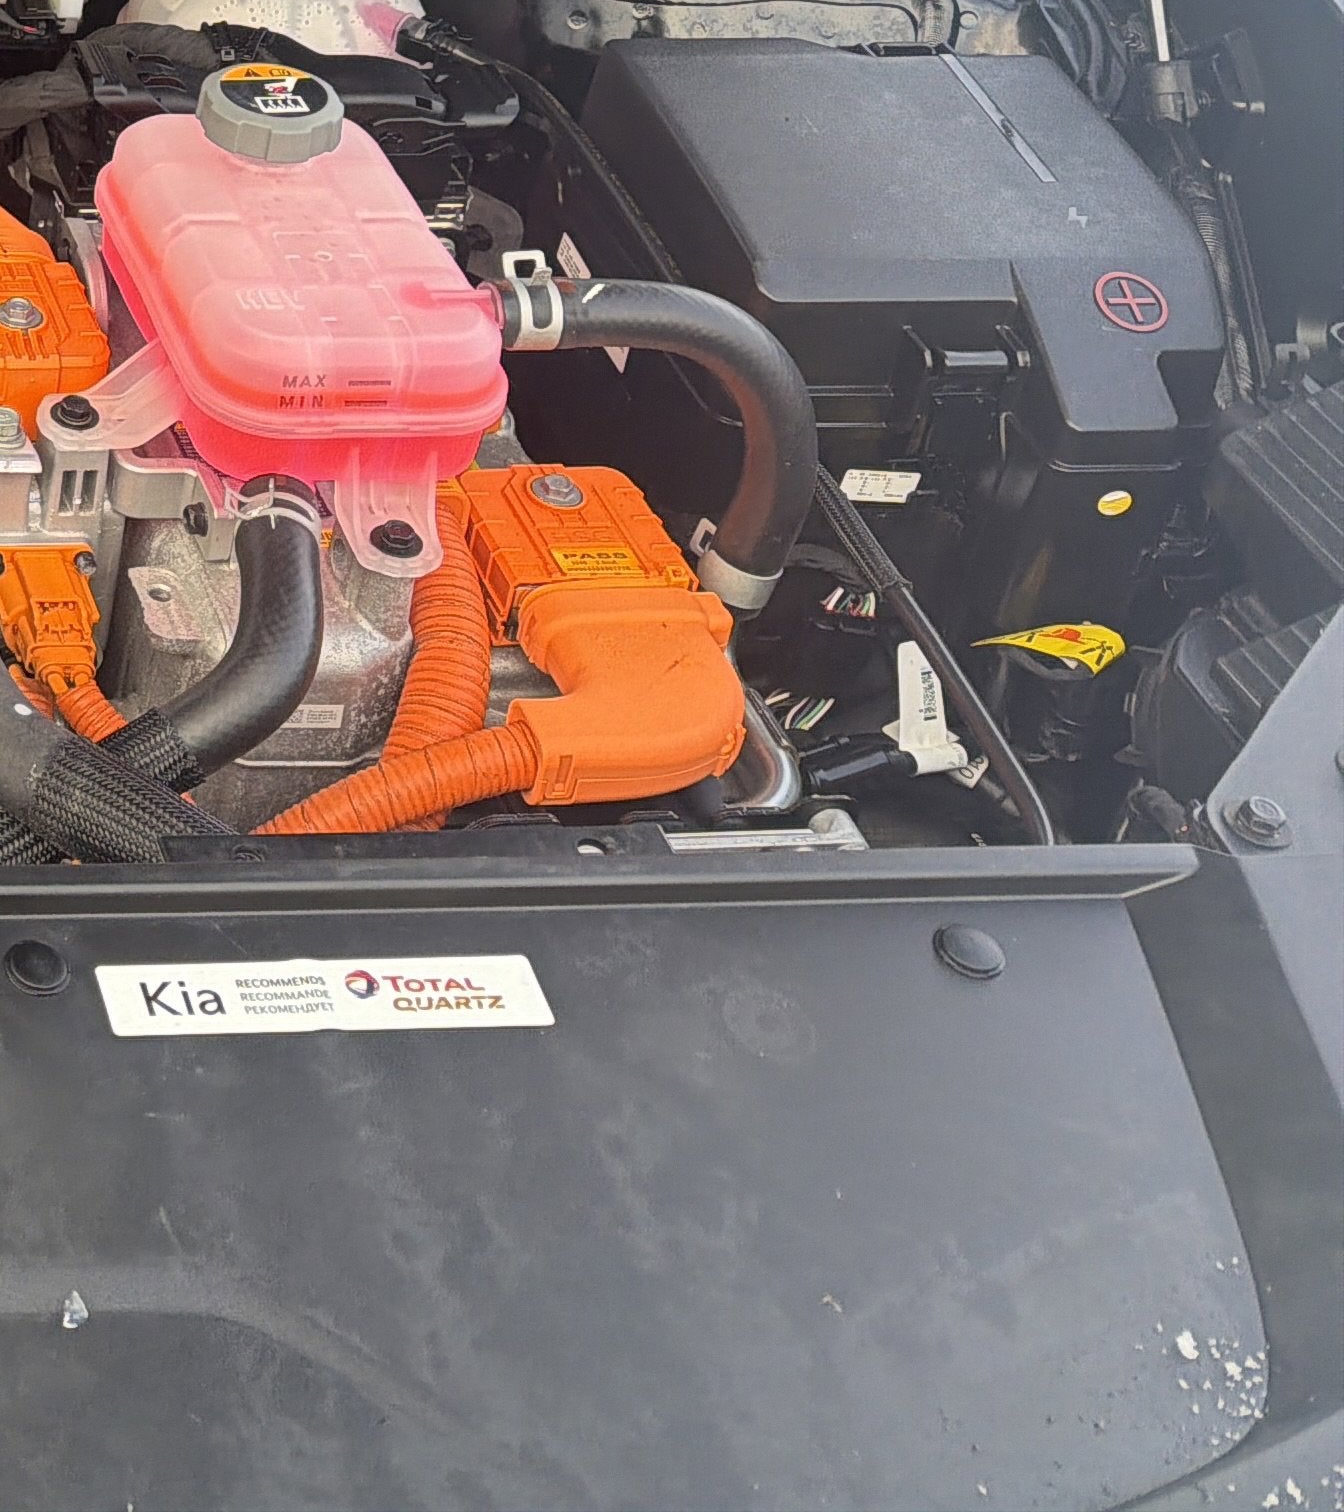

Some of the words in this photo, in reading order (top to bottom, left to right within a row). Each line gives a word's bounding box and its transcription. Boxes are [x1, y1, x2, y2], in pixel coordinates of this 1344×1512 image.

[282, 374, 327, 388] MAX
[279, 395, 324, 408] MIN
[235, 976, 327, 989] RECOMMENDS
[382, 975, 485, 992] TOTAL
[138, 980, 226, 1017] Kia
[239, 989, 331, 1002] RECOMMANDE
[392, 994, 506, 1012] QUARTZ
